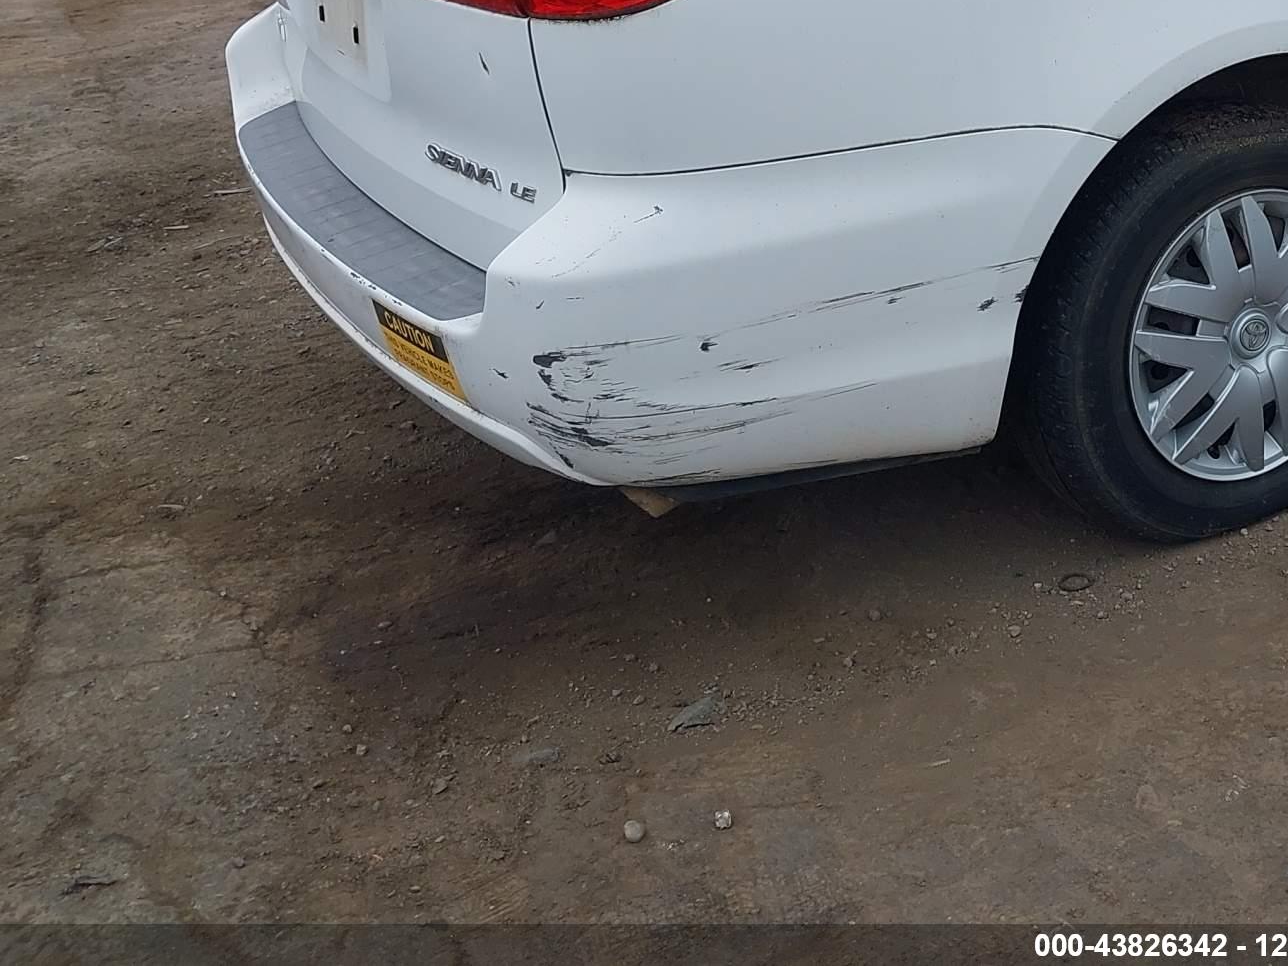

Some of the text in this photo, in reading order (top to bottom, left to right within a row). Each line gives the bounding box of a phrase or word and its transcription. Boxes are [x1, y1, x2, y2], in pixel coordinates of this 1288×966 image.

[425, 142, 537, 204] SIENNA LE
[384, 311, 435, 353] CAUTION
